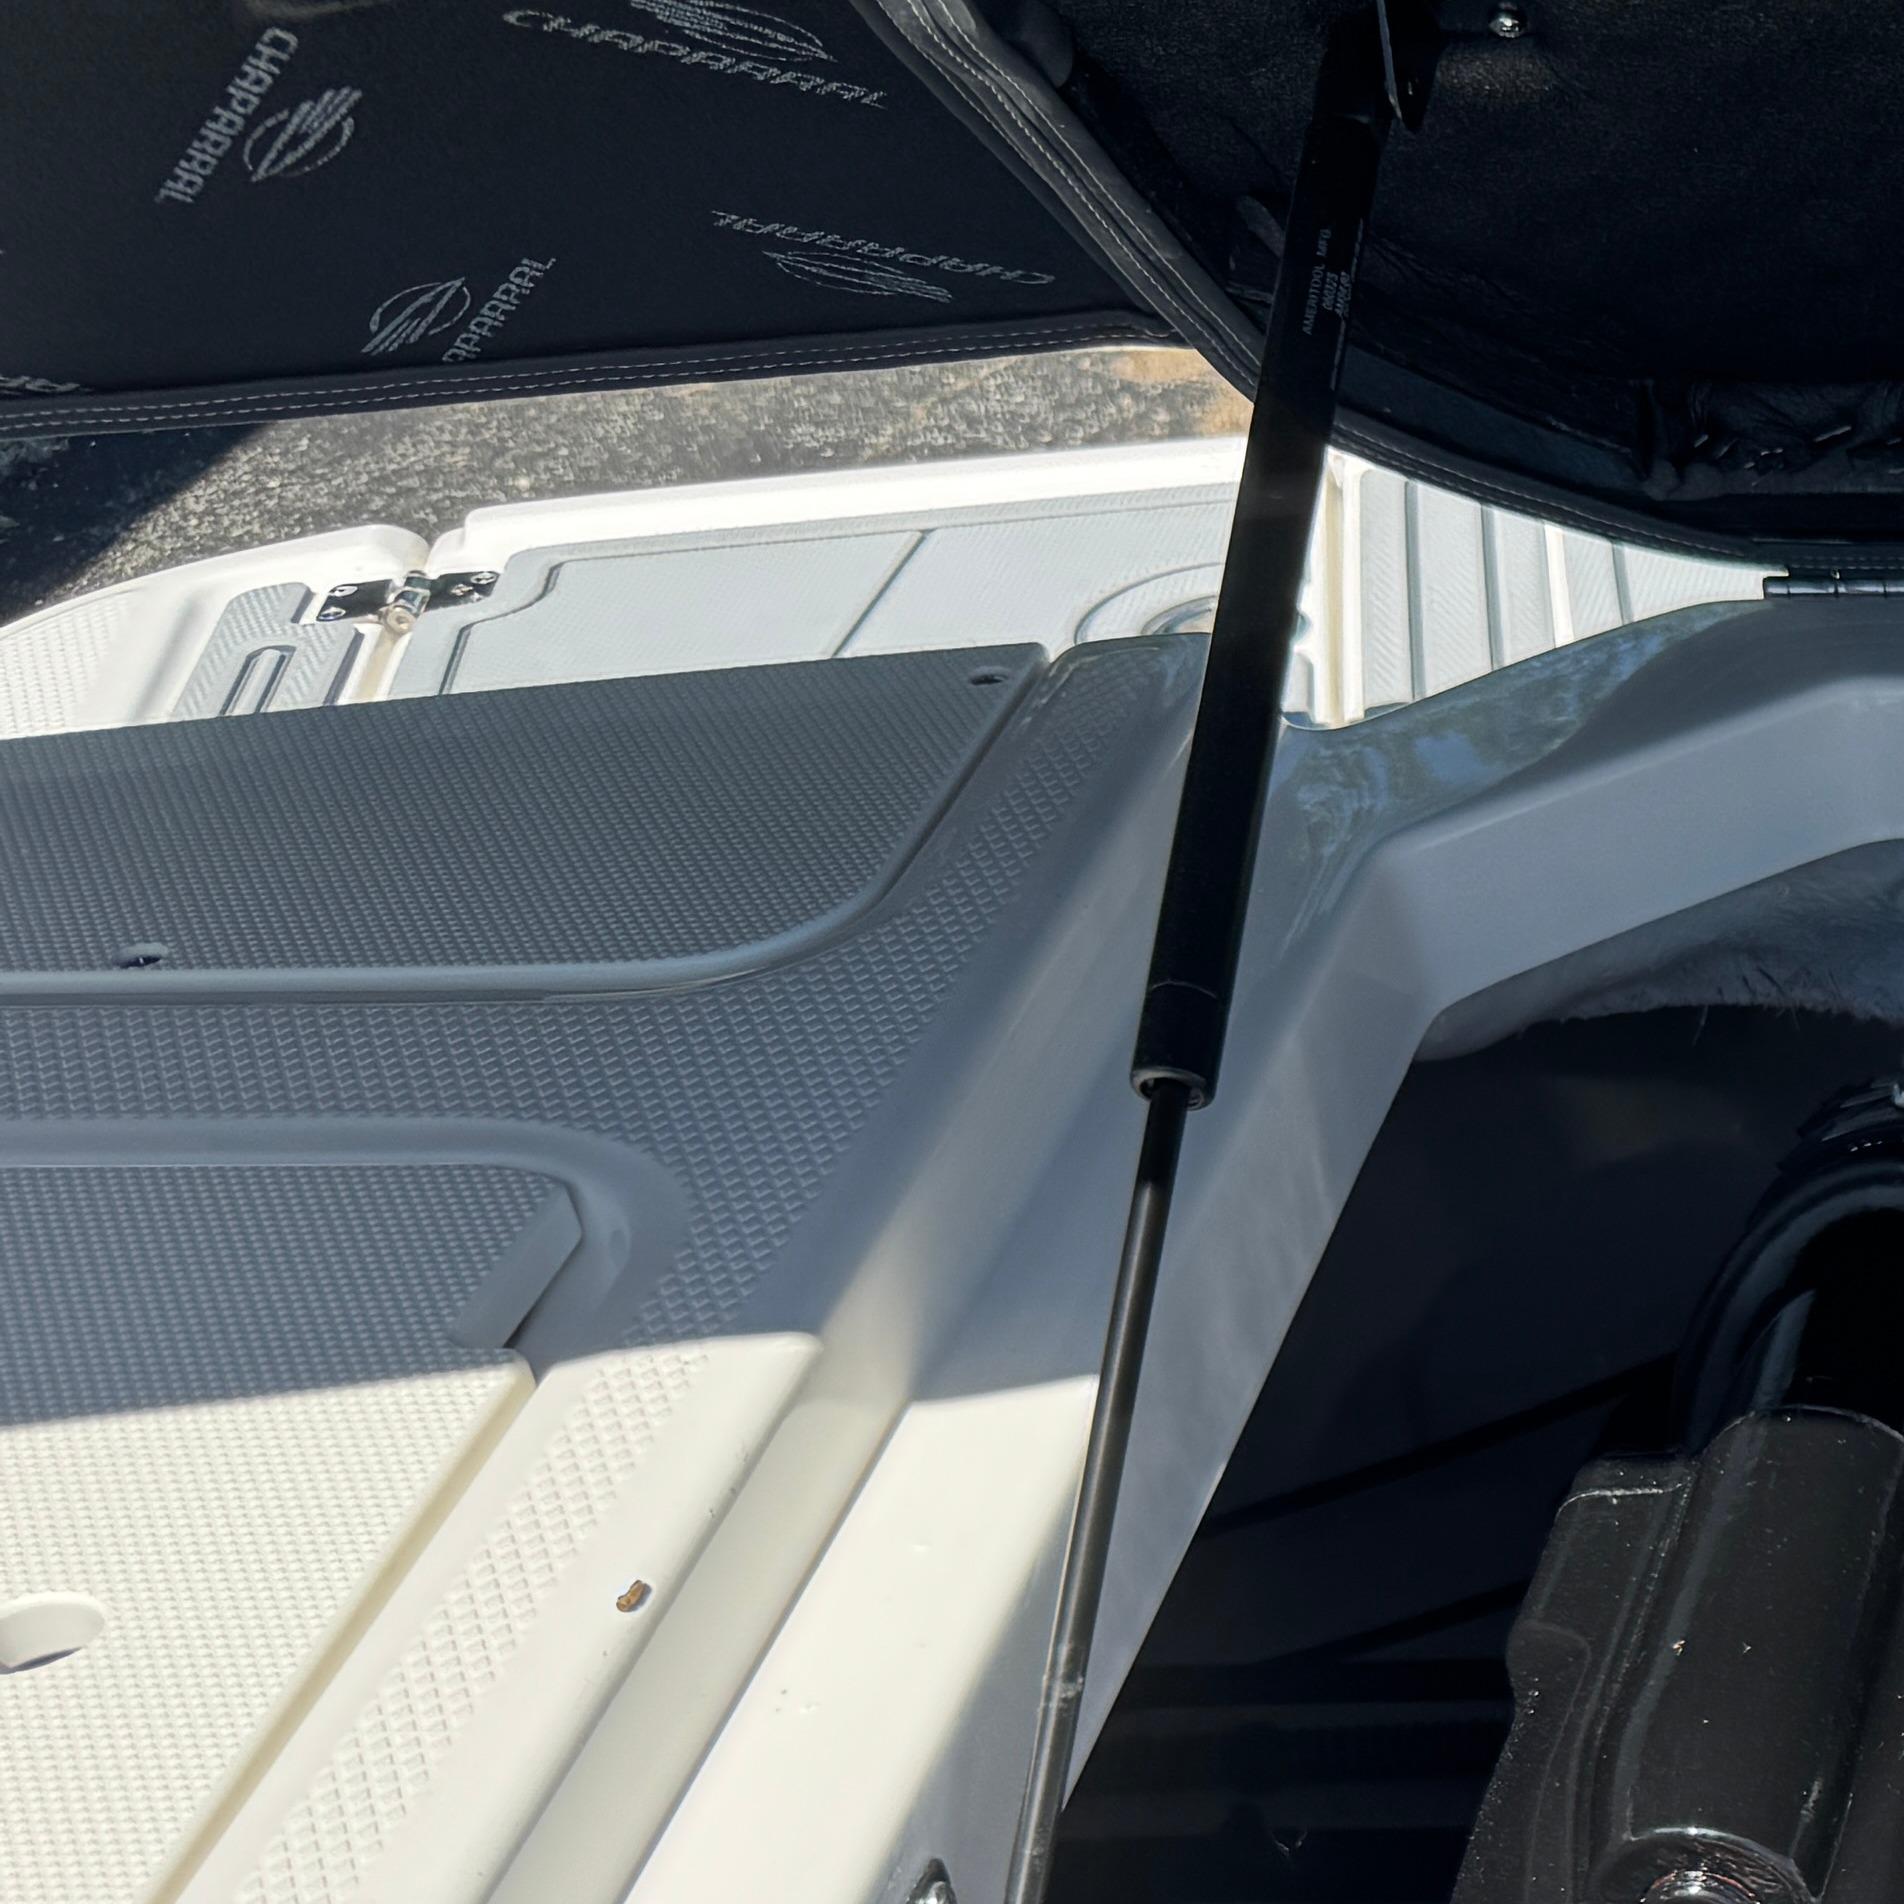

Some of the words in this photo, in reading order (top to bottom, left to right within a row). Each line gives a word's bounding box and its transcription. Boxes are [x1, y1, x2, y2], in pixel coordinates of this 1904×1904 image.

[502, 9, 888, 110] CHAPARRAL
[155, 27, 299, 203] CHAPARRAL
[711, 210, 1056, 286] CHAPARRAL
